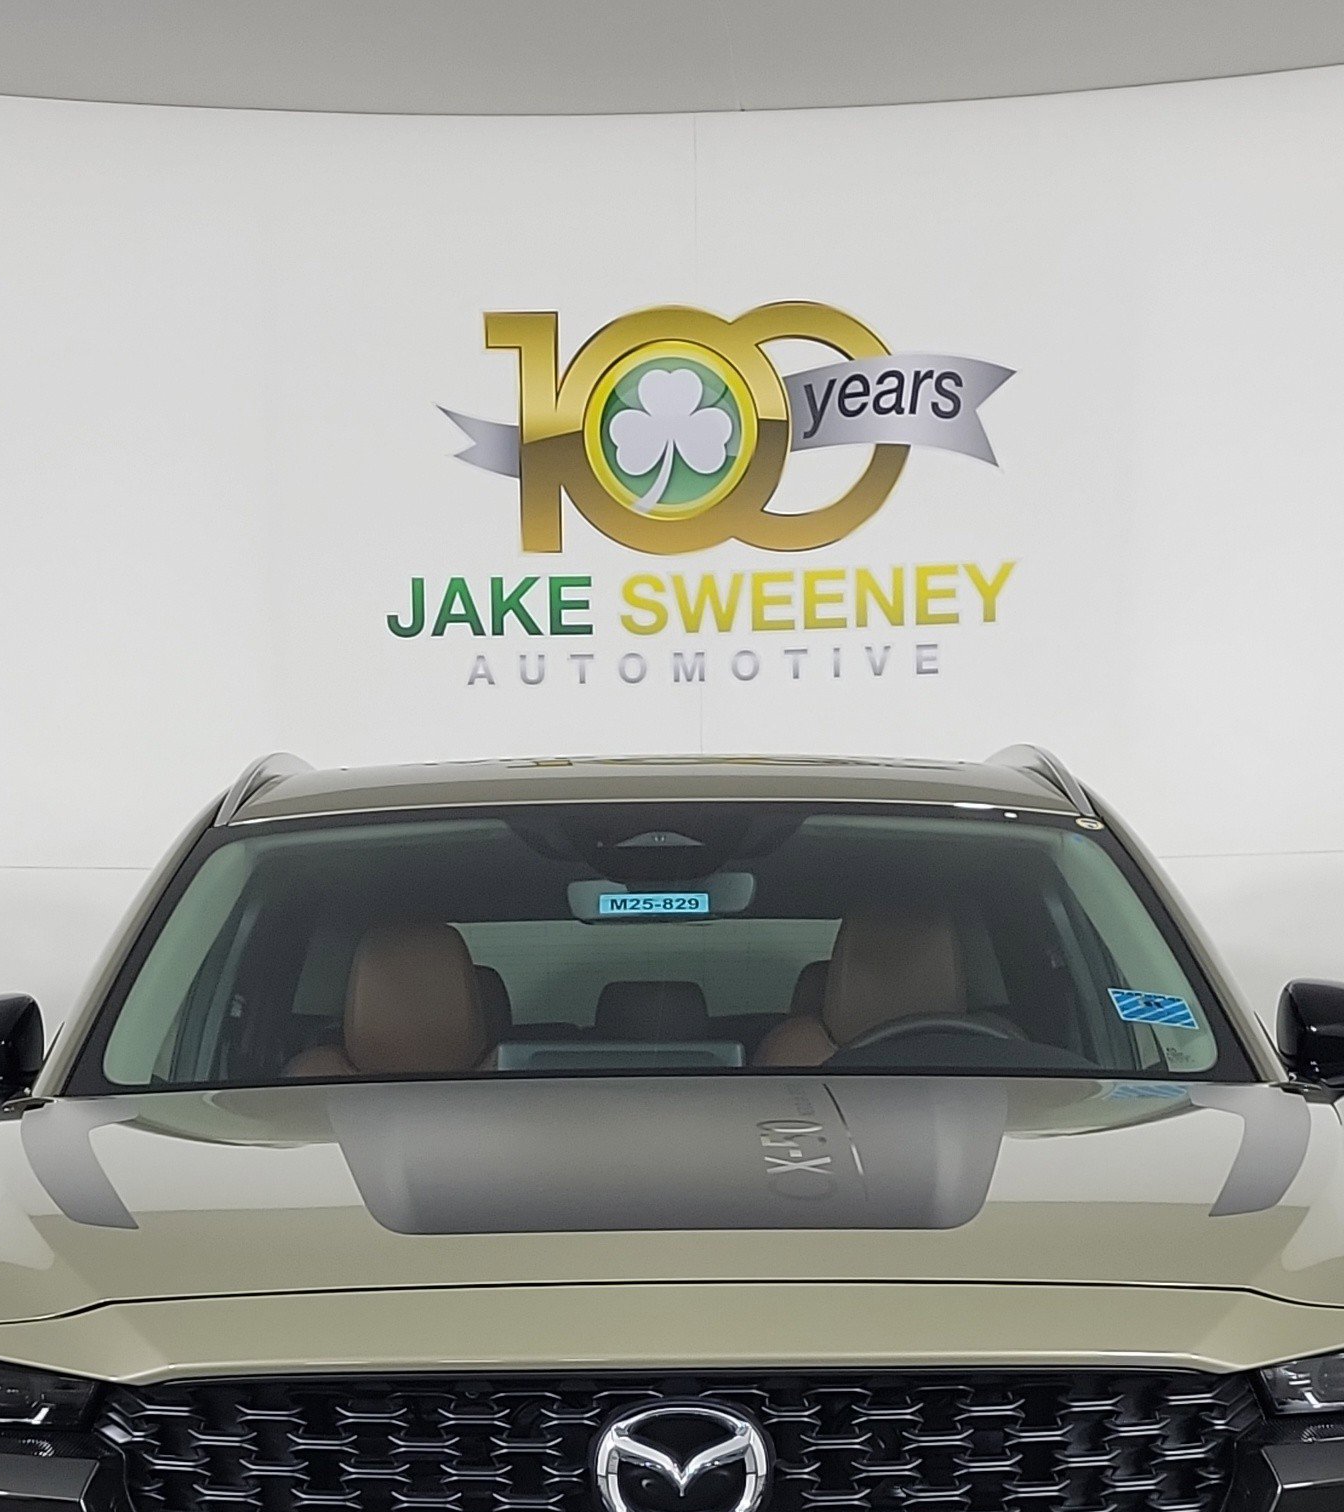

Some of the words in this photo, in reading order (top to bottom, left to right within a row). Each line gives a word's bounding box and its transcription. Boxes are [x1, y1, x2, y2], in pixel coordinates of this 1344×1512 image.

[483, 301, 912, 556] 100
[802, 367, 964, 439] years
[387, 576, 594, 638] JAKE
[619, 562, 1015, 634] SWEENEY
[467, 644, 940, 686] AUTOMOTIVE
[610, 897, 700, 910] M25-829
